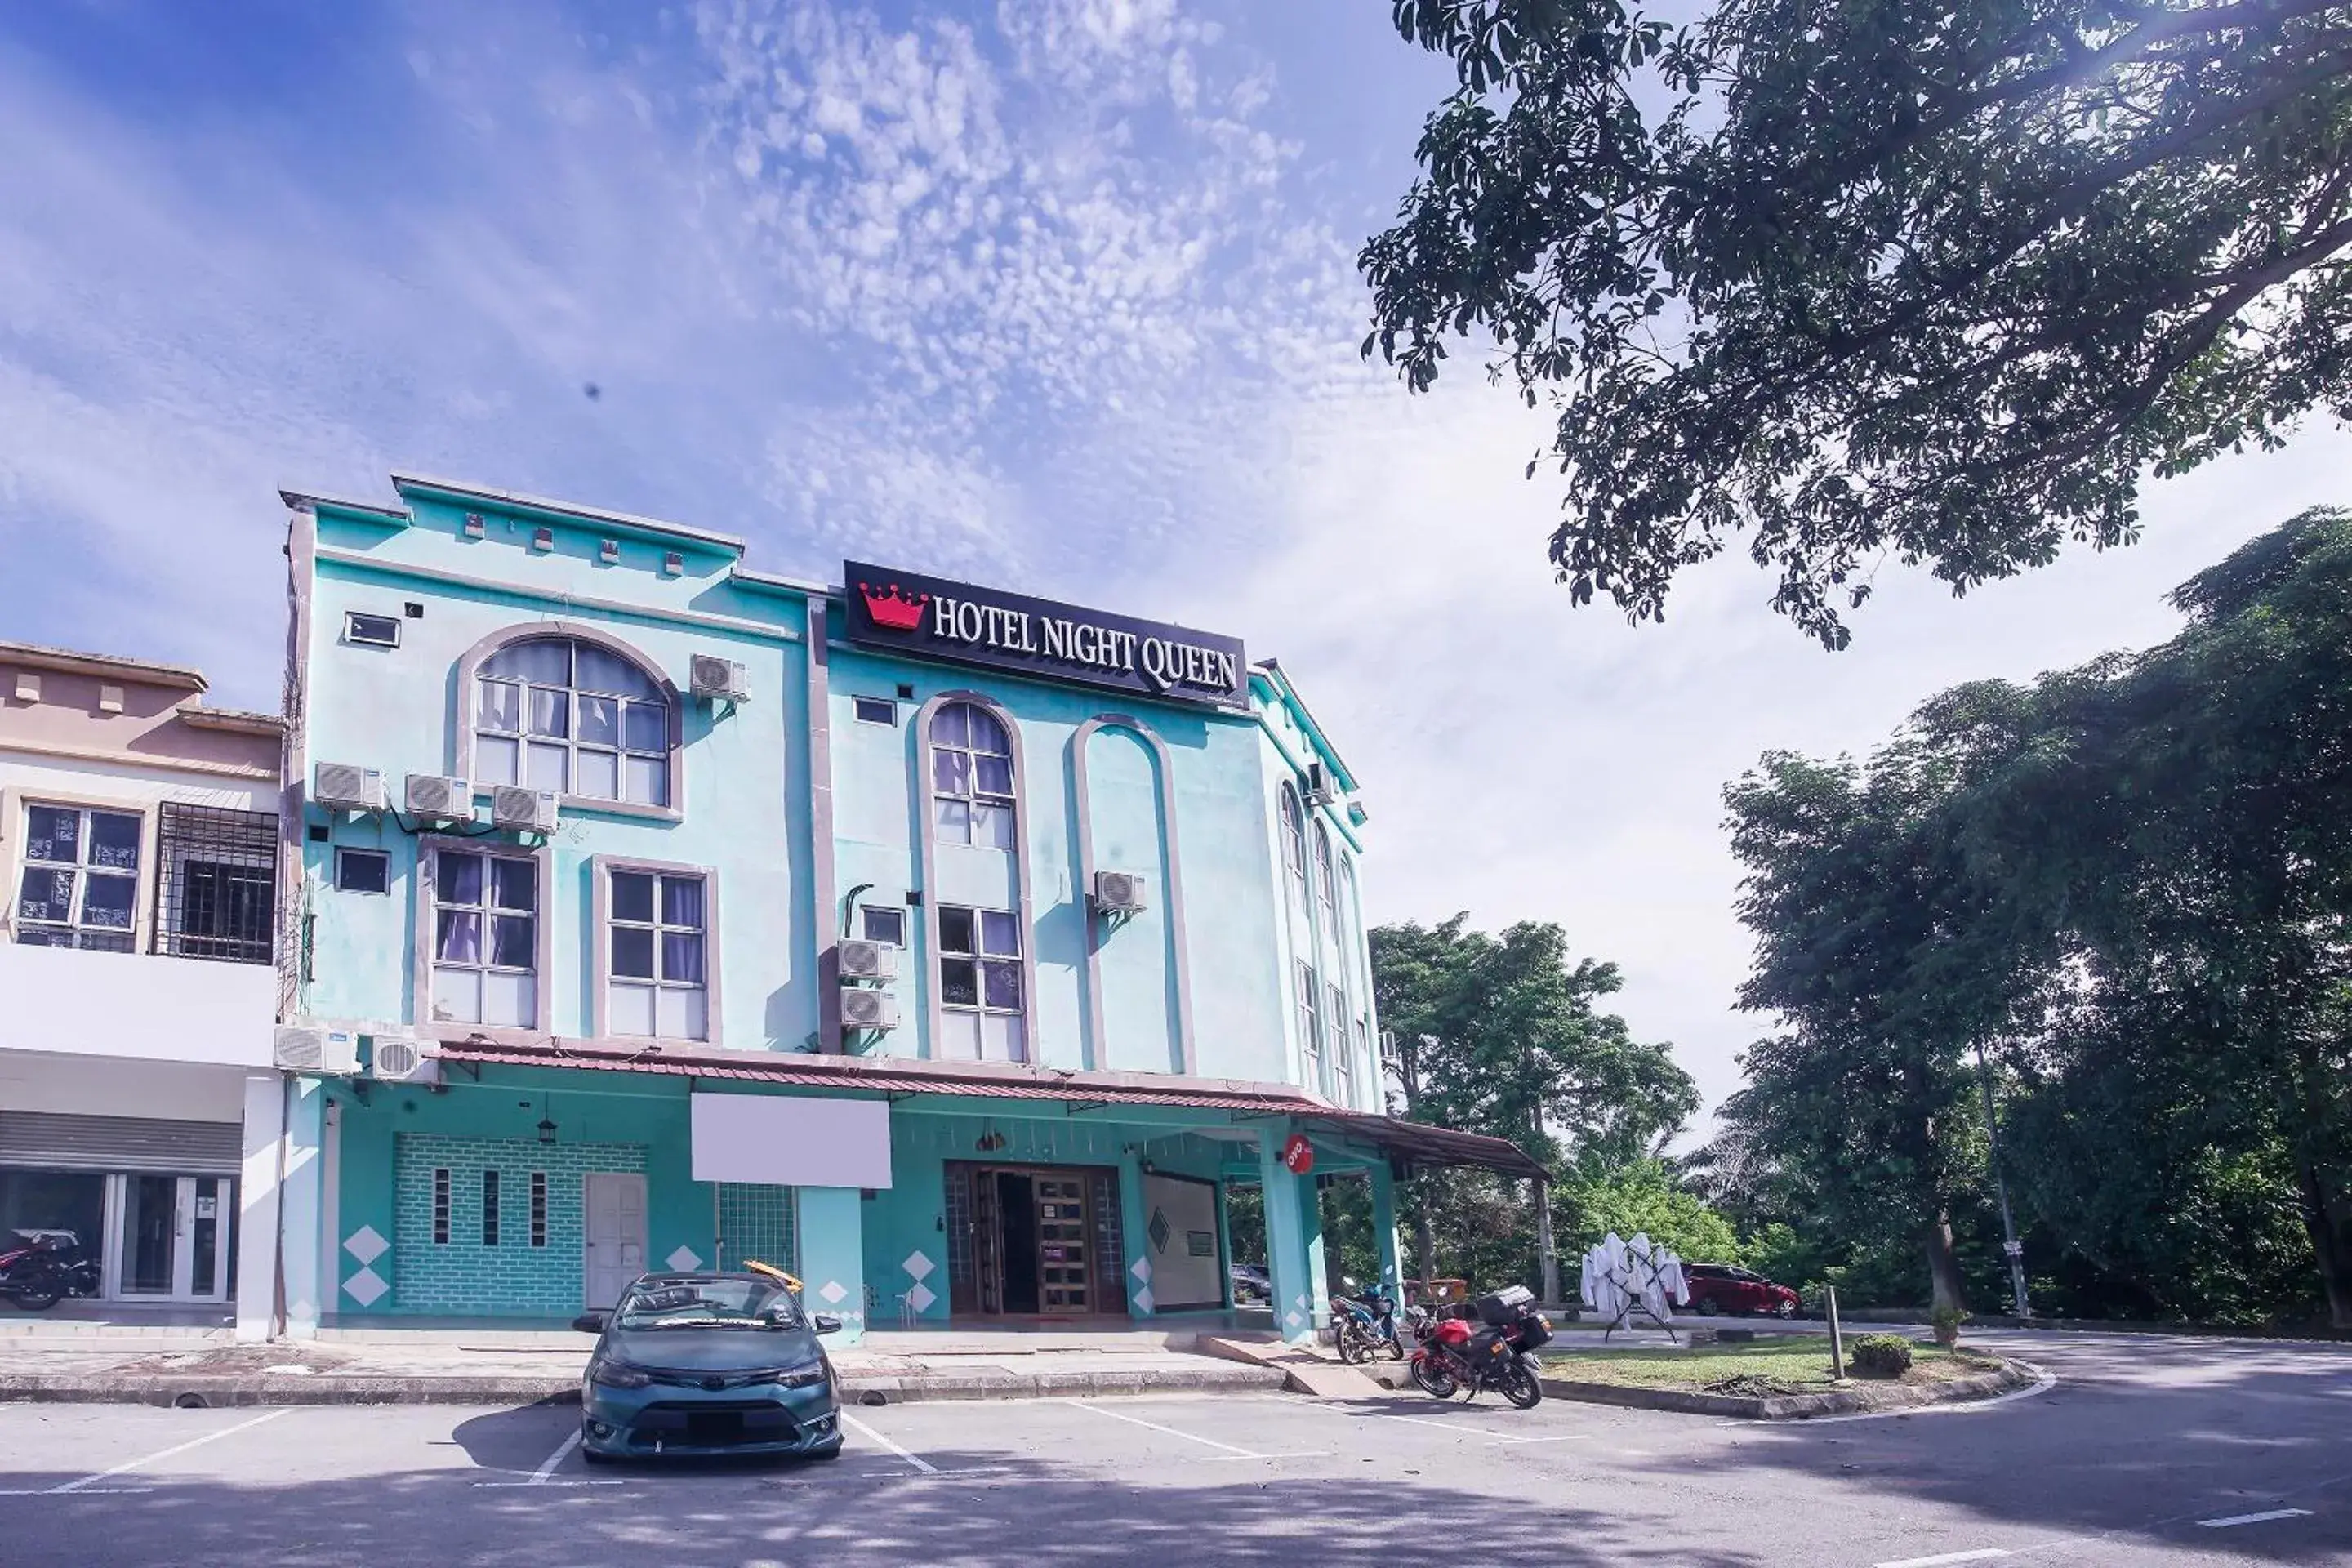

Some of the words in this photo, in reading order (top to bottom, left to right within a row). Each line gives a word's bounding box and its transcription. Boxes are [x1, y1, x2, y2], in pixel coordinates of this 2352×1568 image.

[933, 595, 1037, 653] HOTEL
[1041, 617, 1137, 670] NIGHT
[1142, 637, 1237, 689] QUEEN
[1288, 1142, 1302, 1166] OYO
